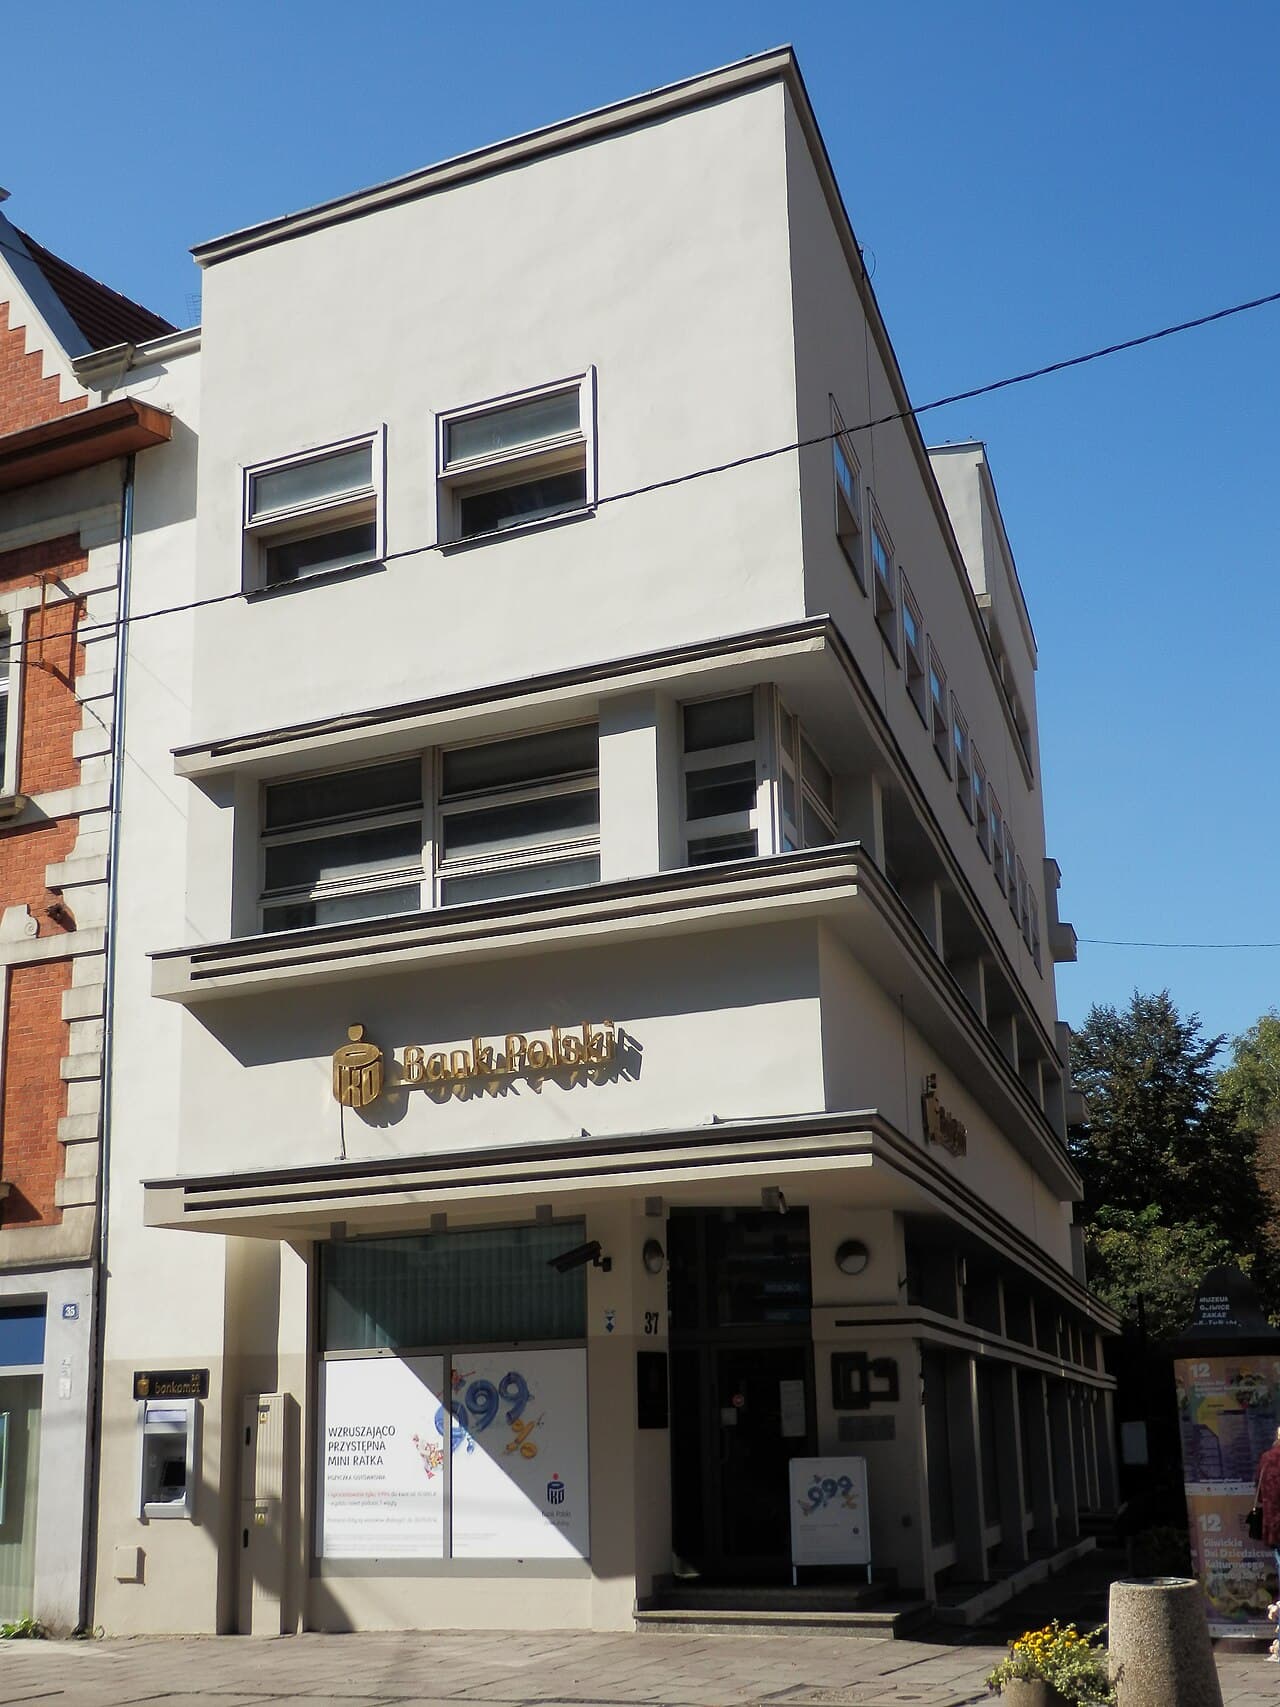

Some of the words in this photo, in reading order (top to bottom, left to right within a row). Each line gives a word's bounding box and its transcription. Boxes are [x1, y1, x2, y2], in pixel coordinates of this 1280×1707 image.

[403, 1036, 493, 1083] Bank
[504, 1020, 616, 1072] Polski
[644, 1311, 660, 1335] 37
[1191, 1363, 1211, 1378] 12
[154, 1381, 201, 1394] bankomat
[328, 1425, 396, 1439] WZRUSZAJĄCO
[328, 1440, 386, 1454] PRZYSTĘPNA
[327, 1456, 350, 1467] MINI
[352, 1455, 384, 1466] RATKA
[1199, 1513, 1222, 1532] 12
